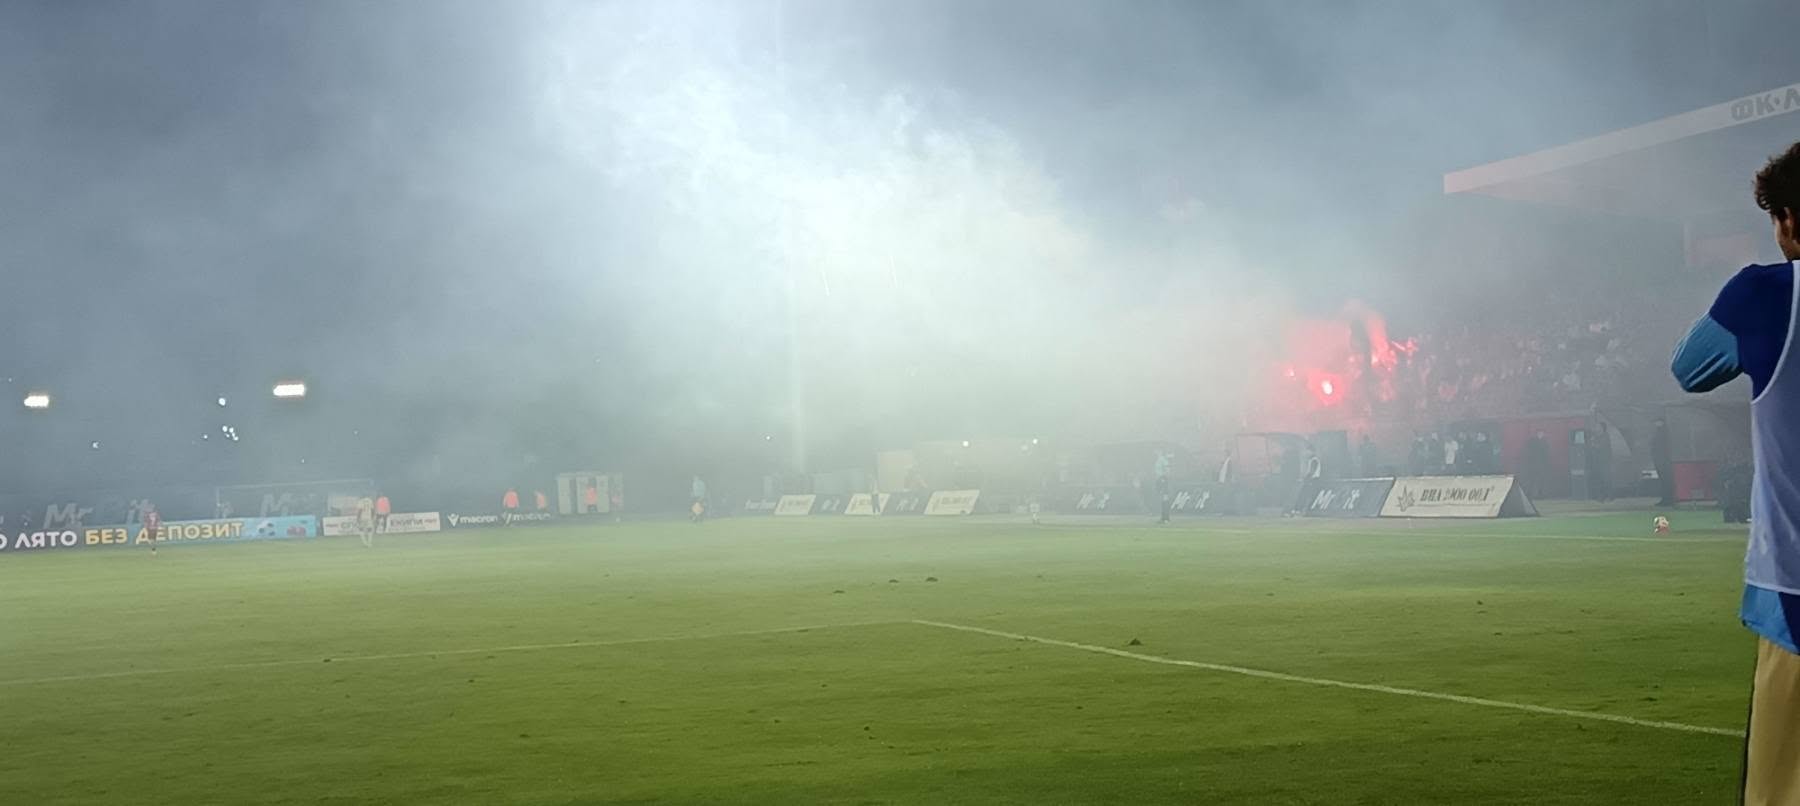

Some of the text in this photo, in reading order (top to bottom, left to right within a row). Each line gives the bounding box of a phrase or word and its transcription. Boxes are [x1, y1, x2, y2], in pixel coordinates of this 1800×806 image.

[460, 514, 497, 523] macron
[15, 530, 77, 548] ЛЯТО
[85, 528, 128, 545] БЕЗ
[136, 522, 242, 545] ДЕПОЗИТ
